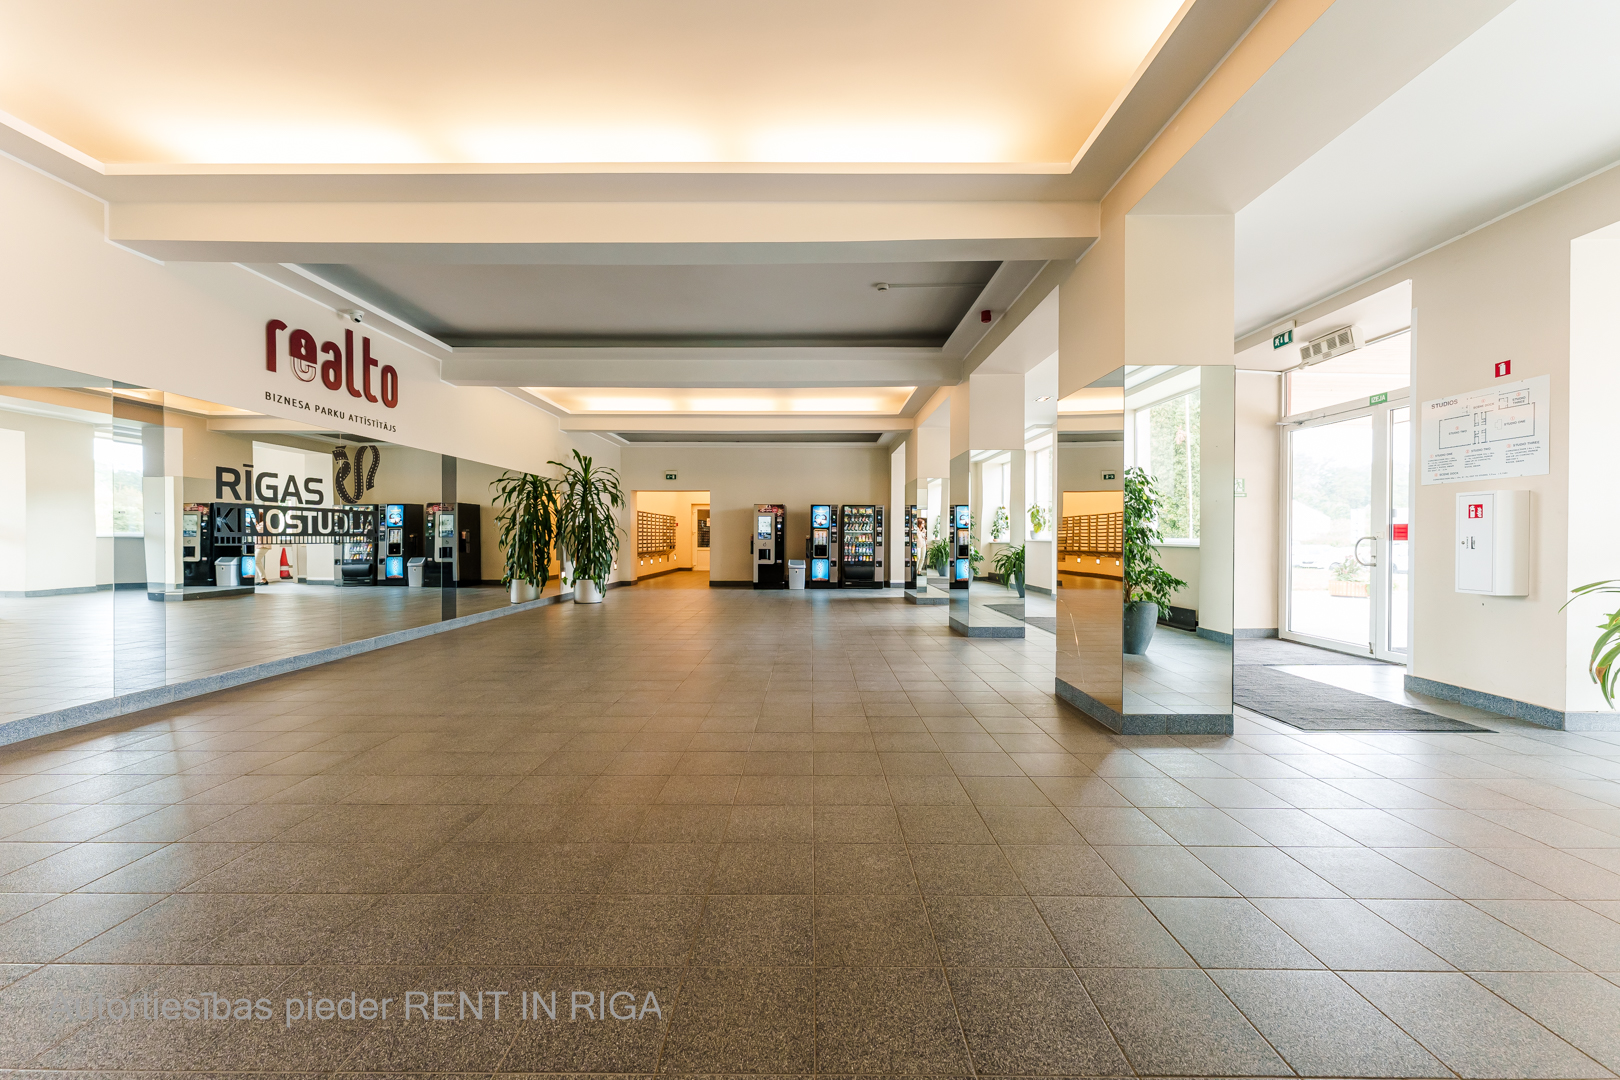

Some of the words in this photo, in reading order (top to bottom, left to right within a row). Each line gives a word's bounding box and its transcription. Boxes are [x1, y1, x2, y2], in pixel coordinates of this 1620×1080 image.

[265, 318, 398, 409] realto
[264, 391, 311, 411] BIZNESA
[314, 404, 345, 420] PARKU
[348, 414, 397, 433] ATTĪSTĪTĀJS
[1371, 395, 1386, 403] IZEJA
[1431, 398, 1458, 410] STUDIOS
[215, 463, 325, 506] RĪGAS
